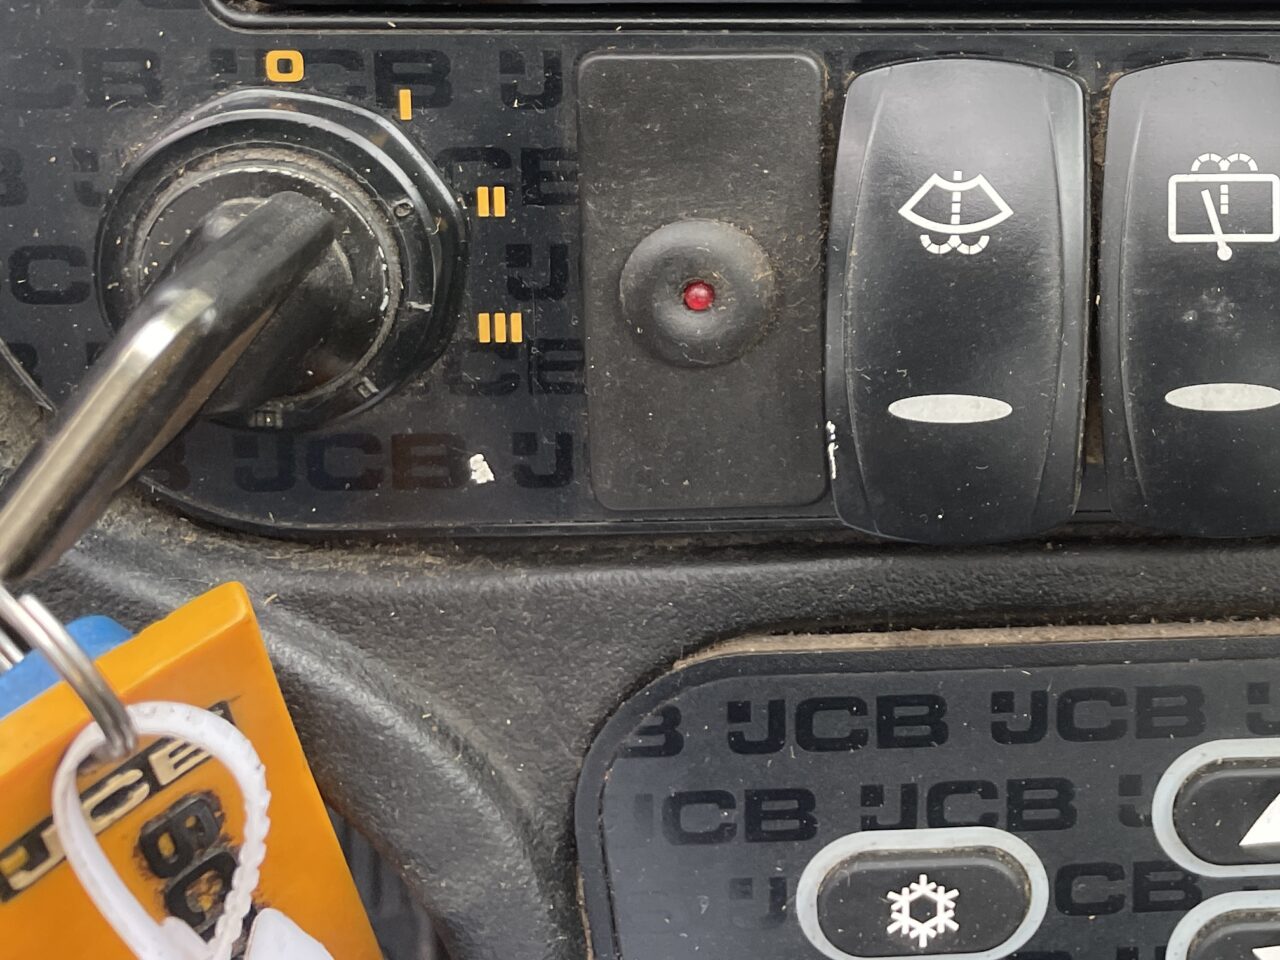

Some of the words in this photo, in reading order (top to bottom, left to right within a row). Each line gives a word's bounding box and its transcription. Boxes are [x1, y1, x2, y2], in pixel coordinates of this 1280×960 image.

[727, 693, 949, 755] JCB
[991, 685, 1207, 745] JCB
[860, 776, 1078, 832] JCB
